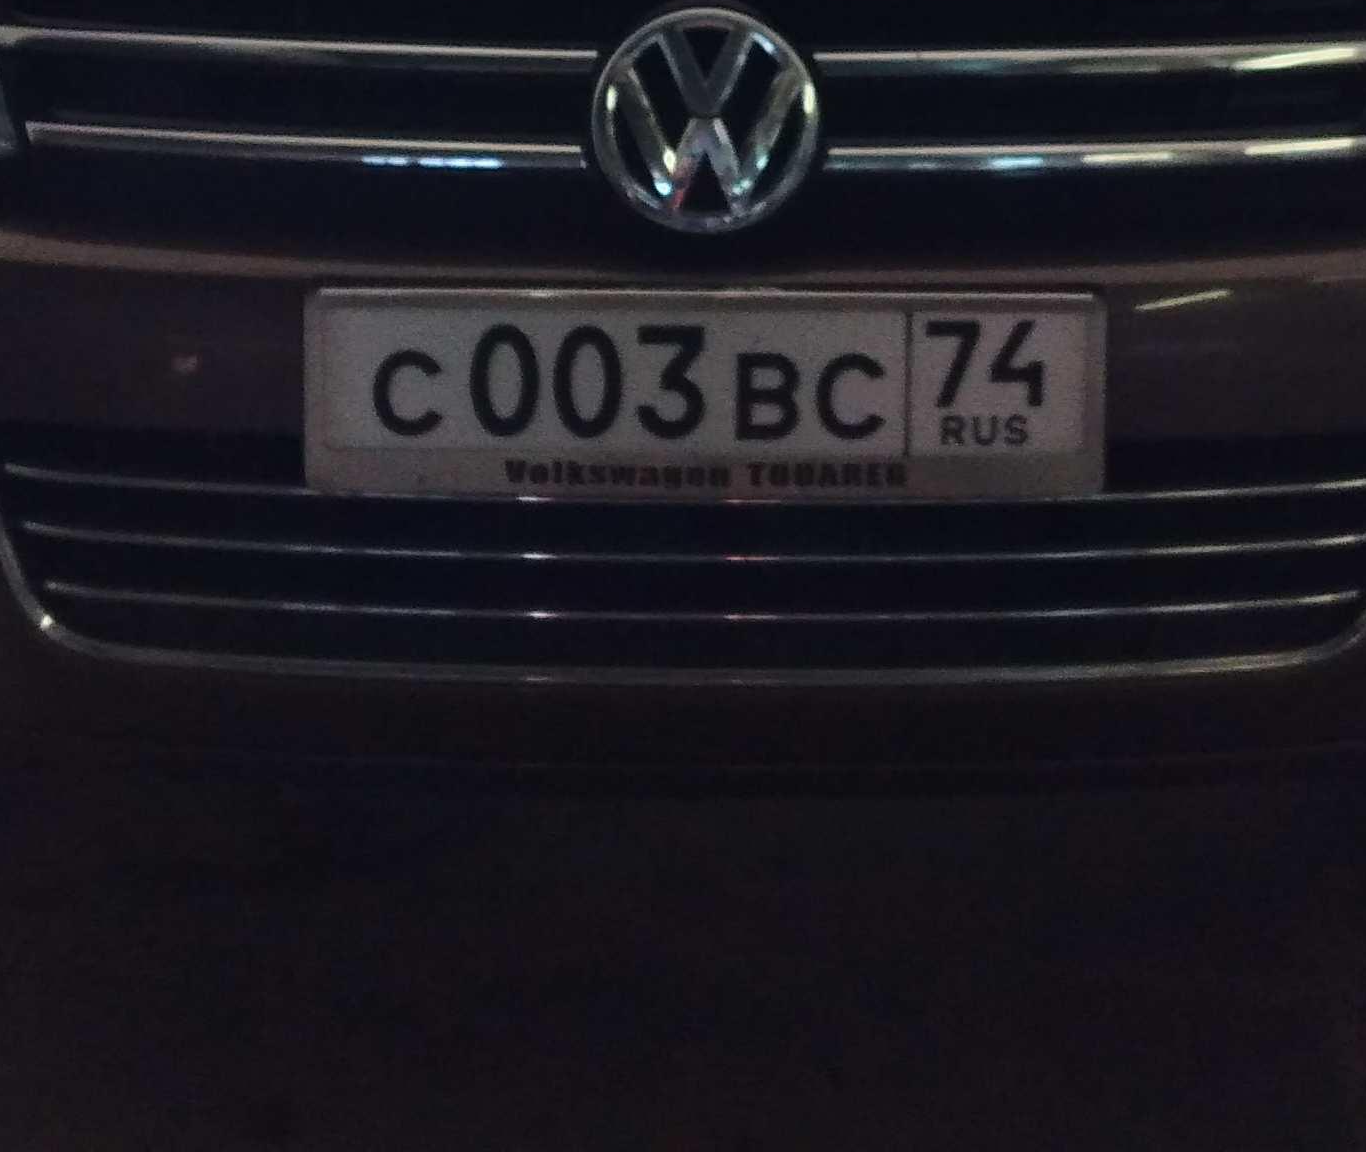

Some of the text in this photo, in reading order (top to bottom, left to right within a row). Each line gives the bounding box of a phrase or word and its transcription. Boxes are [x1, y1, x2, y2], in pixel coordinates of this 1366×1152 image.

[372, 319, 1046, 442] C003BC 74
[939, 413, 1031, 448] RUS
[504, 459, 731, 489] Volkswagen
